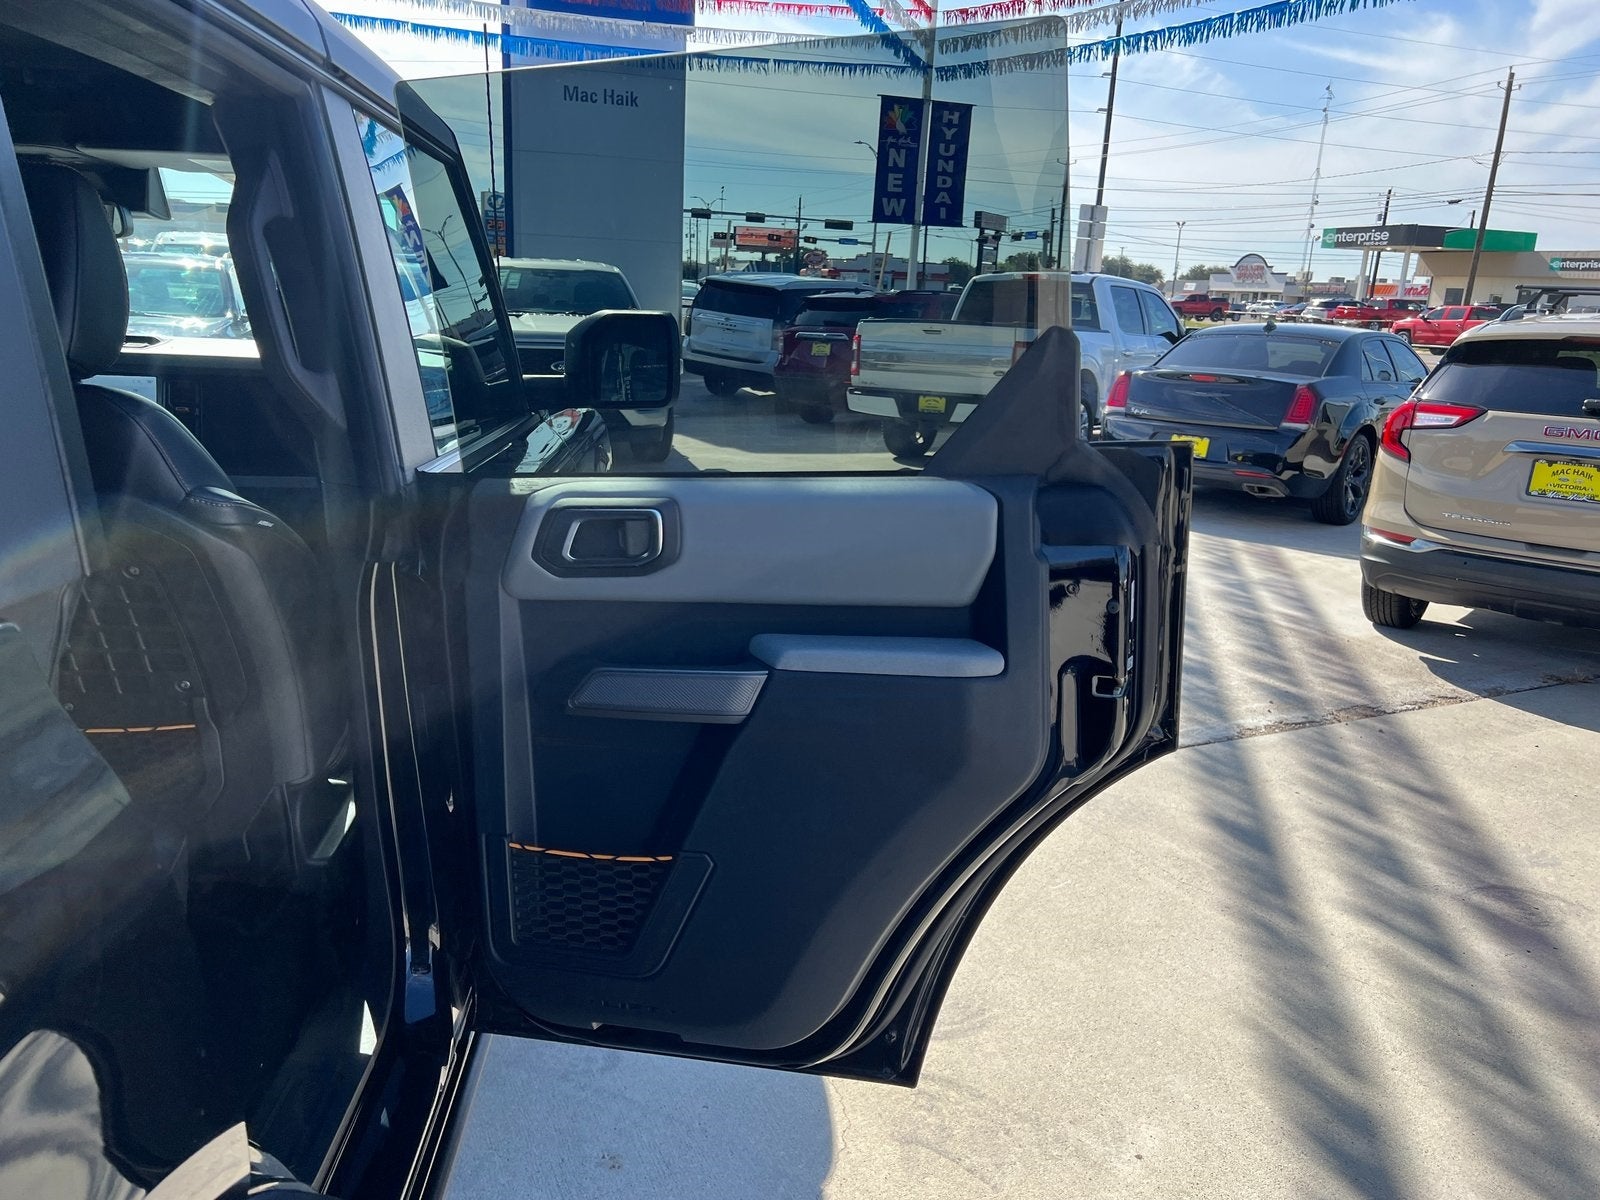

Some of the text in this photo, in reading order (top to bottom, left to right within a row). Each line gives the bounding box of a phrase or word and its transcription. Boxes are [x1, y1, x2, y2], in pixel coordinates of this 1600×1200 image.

[563, 85, 638, 107] Mac Haik
[934, 110, 960, 219] HYUNDAI
[881, 147, 906, 216] NEW
[1324, 229, 1389, 244] enterprise
[1551, 260, 1600, 270] enterpris
[1551, 468, 1594, 481] MAC HAIK
[1552, 483, 1586, 491] VICTORIA
